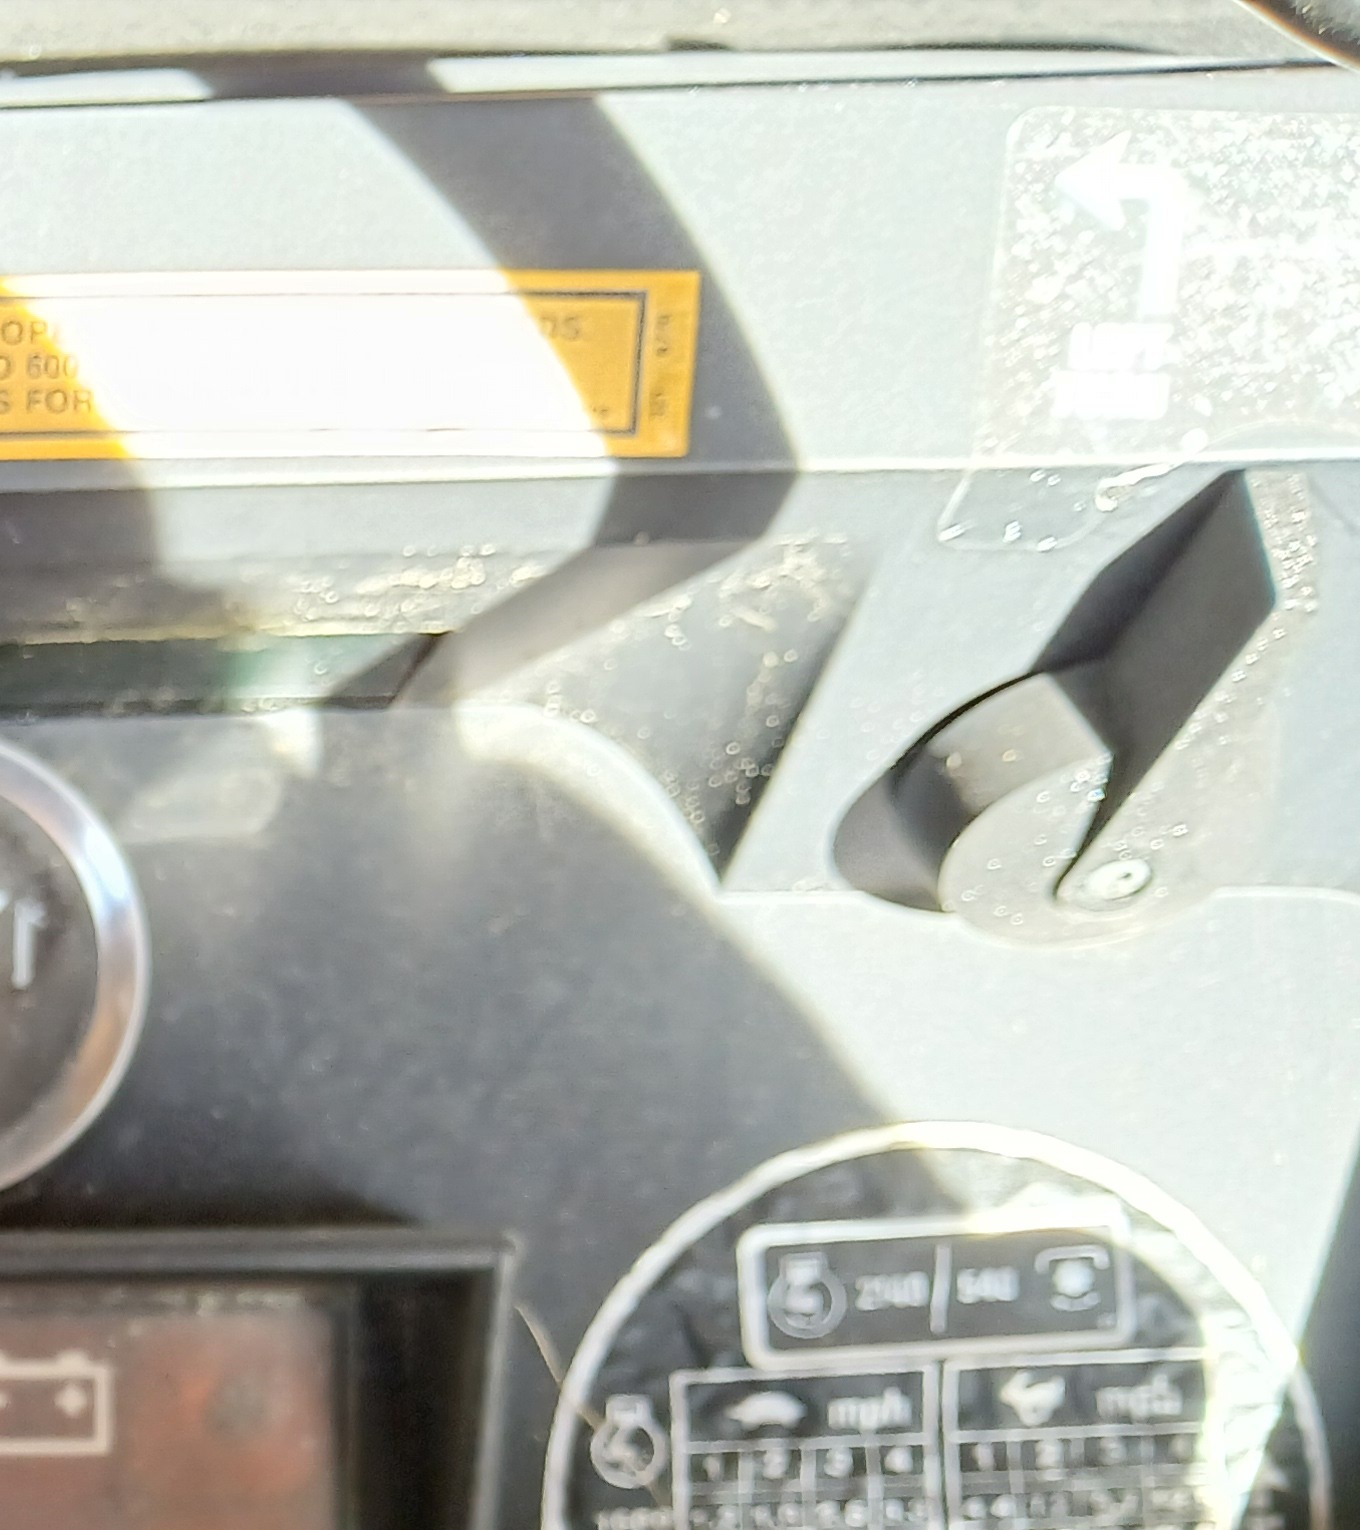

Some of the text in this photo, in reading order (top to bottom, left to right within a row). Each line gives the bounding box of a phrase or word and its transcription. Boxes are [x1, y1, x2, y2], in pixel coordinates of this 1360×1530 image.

[26, 388, 94, 415] FOR
[828, 1385, 913, 1433] mph
[1094, 1373, 1182, 1421] mph
